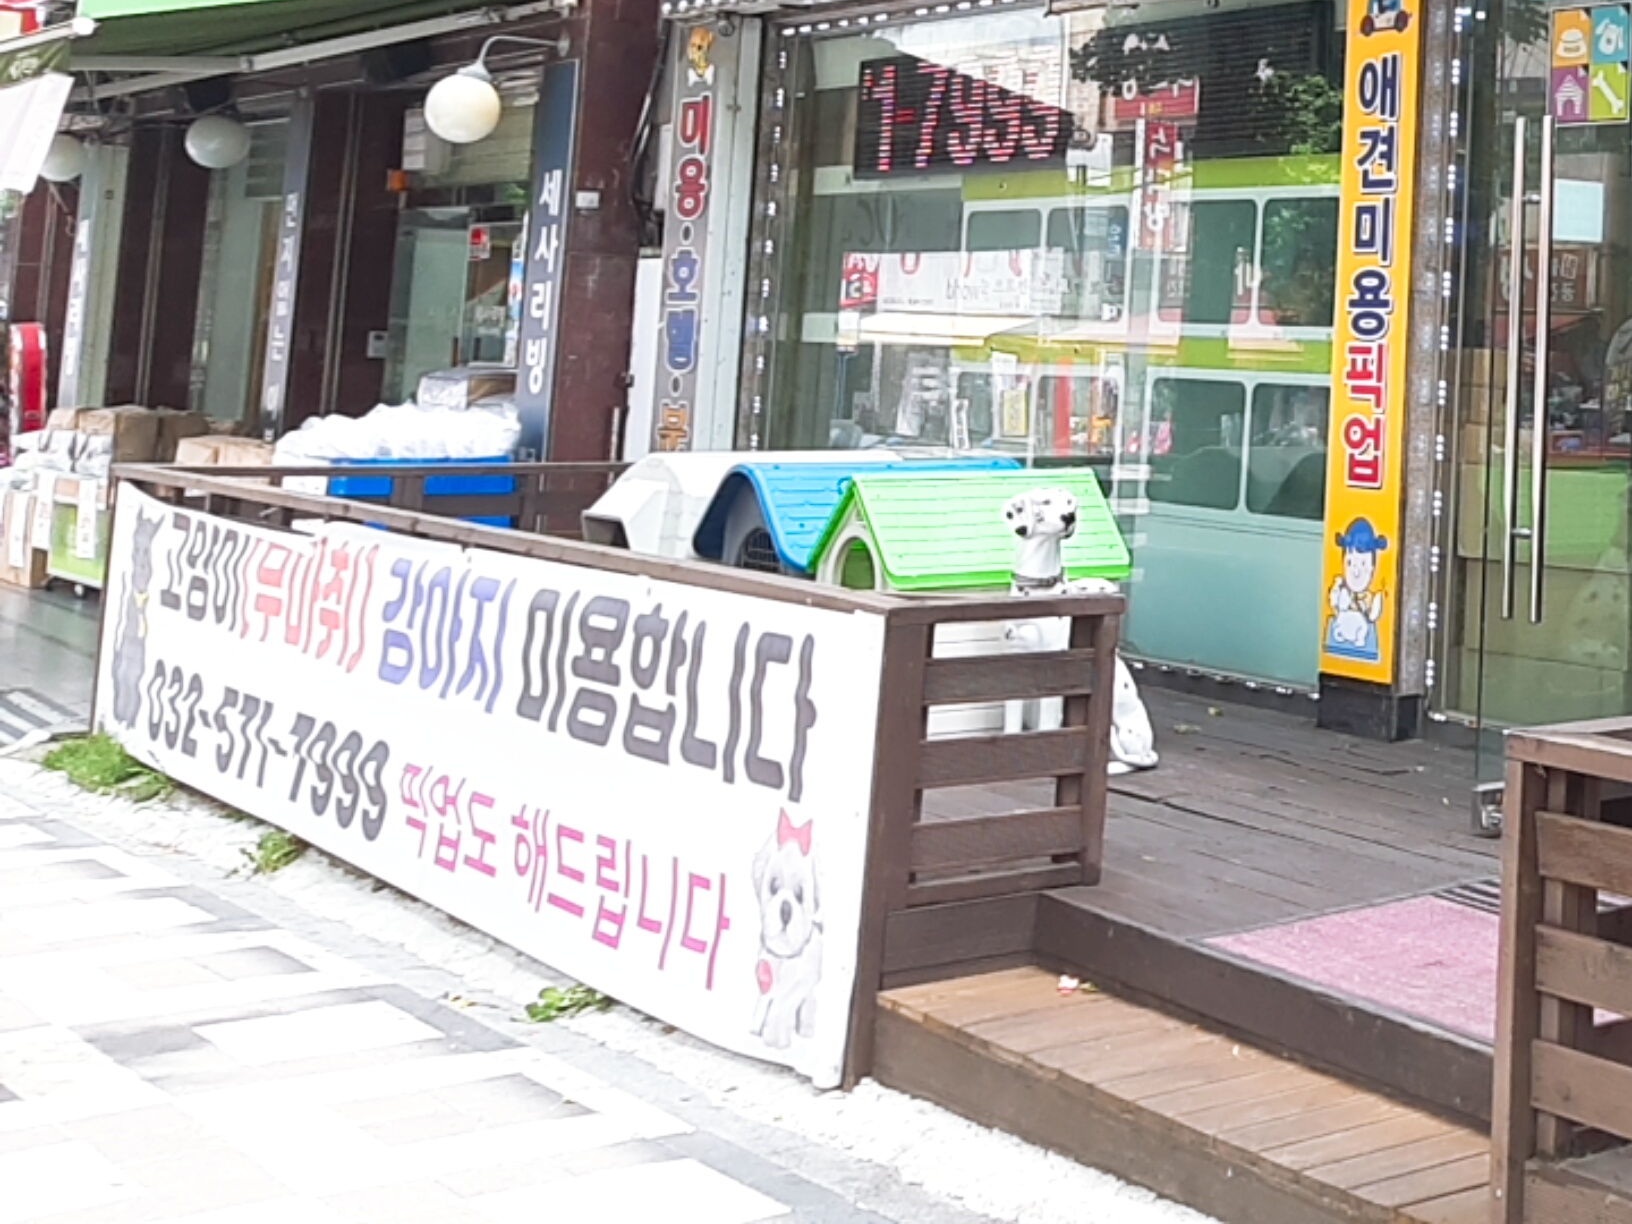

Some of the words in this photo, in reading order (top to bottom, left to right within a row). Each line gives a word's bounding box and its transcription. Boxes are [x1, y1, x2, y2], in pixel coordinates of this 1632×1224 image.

[674, 91, 713, 221] 미용
[525, 168, 564, 396] 세사리빙
[377, 556, 517, 714] 강아지
[515, 587, 818, 804] 미용합니다
[146, 658, 390, 842] 032-571-7999
[399, 762, 497, 878] 픽업도
[510, 803, 731, 991] 해드립니다
